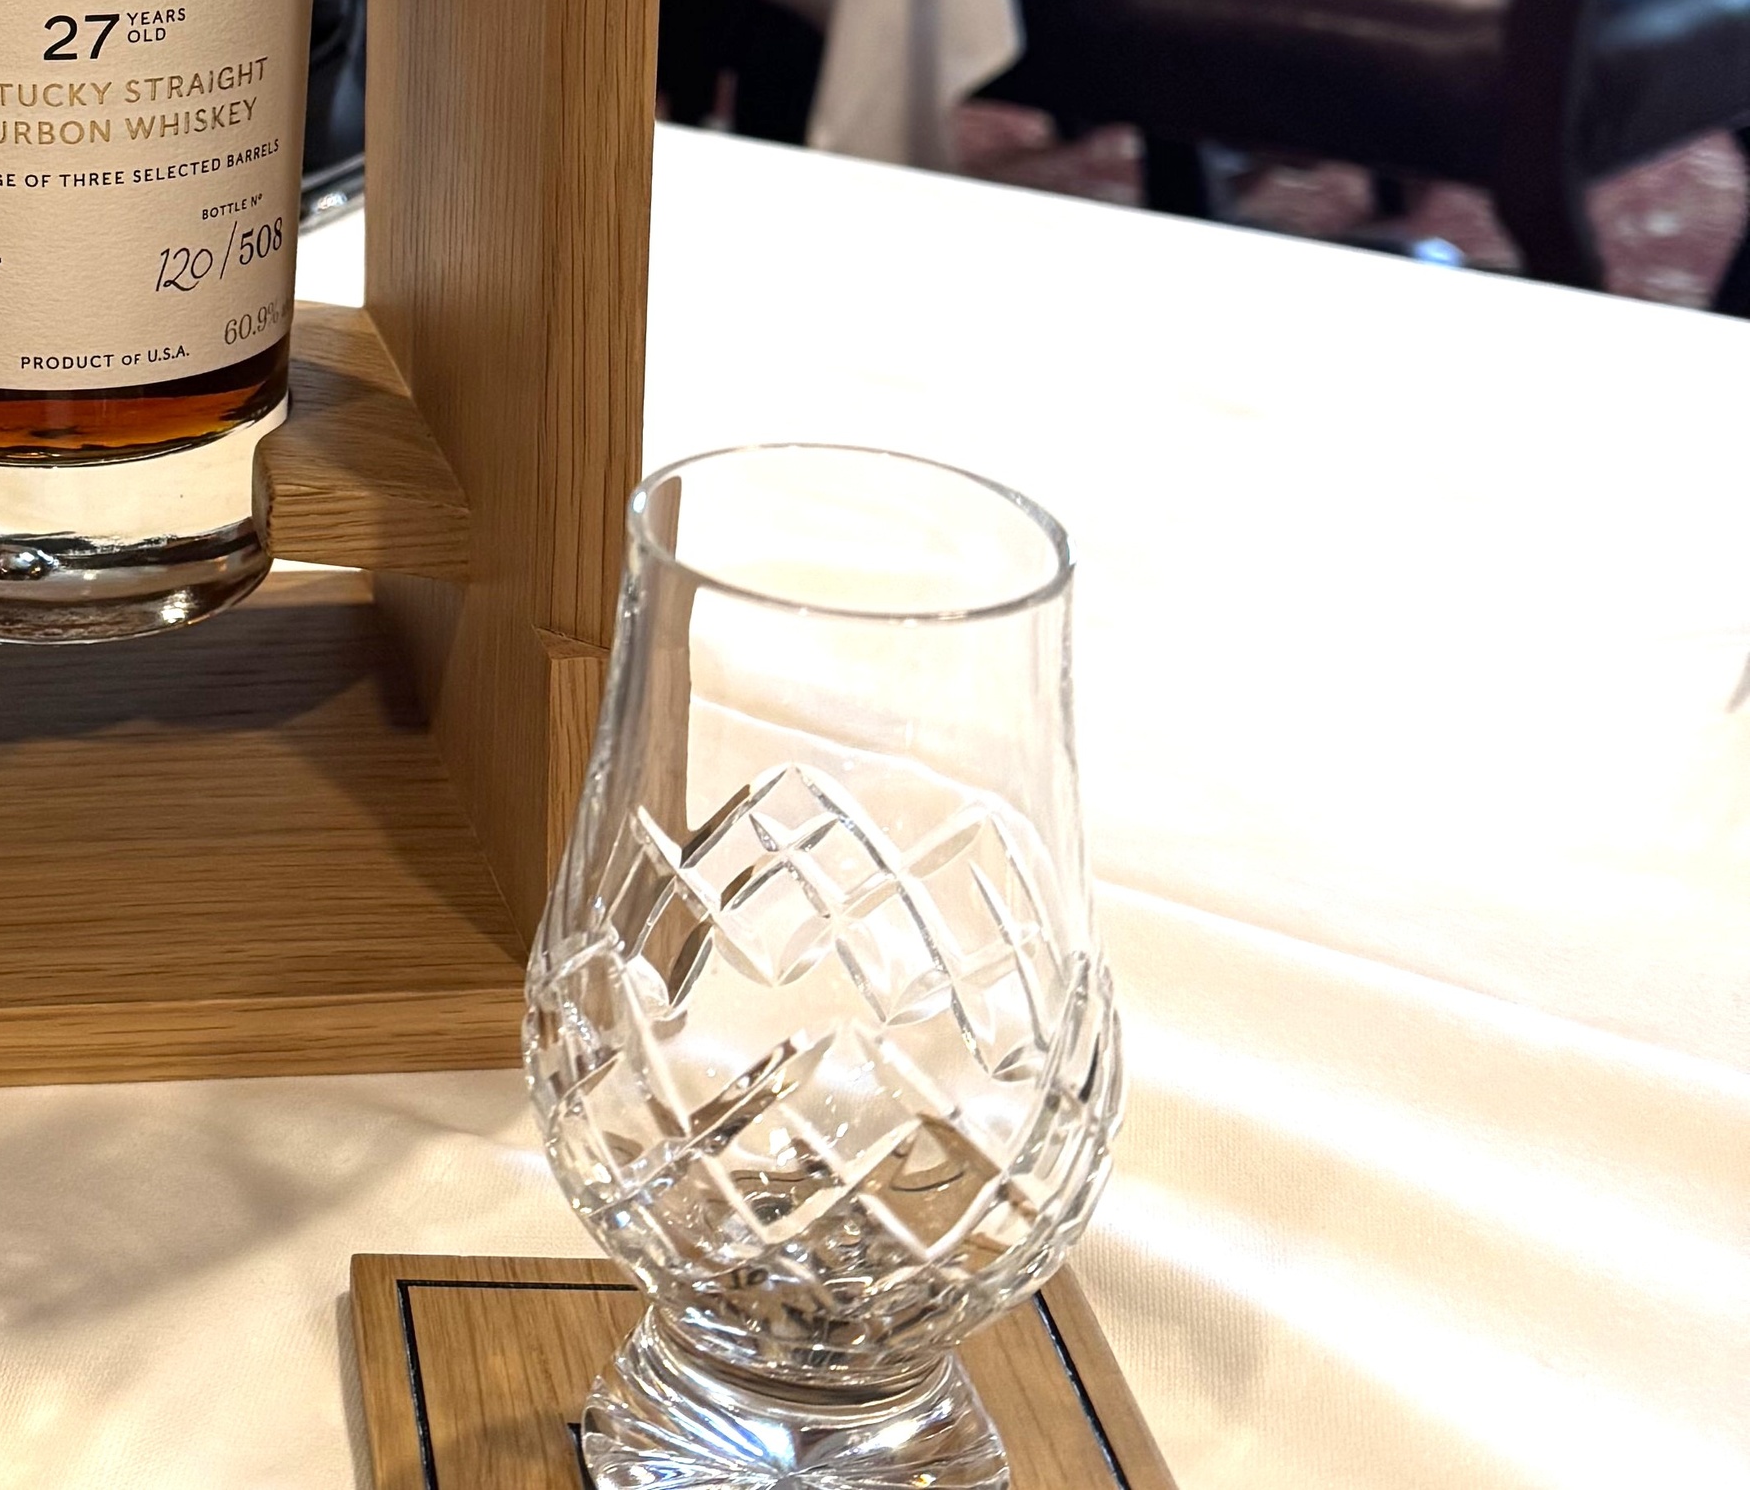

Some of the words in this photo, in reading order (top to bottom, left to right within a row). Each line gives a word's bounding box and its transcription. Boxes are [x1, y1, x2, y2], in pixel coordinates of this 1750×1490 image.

[44, 14, 120, 60] 27
[127, 8, 185, 26] YEARS
[128, 28, 166, 43] OLD
[125, 56, 268, 101] STRAIGHT
[125, 95, 257, 141] WHISKEY
[25, 175, 51, 187] OF
[59, 171, 124, 187] THREE
[133, 158, 220, 183] SELECTED
[227, 139, 278, 168] BARRELS
[202, 198, 247, 220] BOTTLE
[21, 354, 114, 369] PRODUCT
[122, 353, 141, 365] OF
[148, 345, 189, 362] U.S.A.
